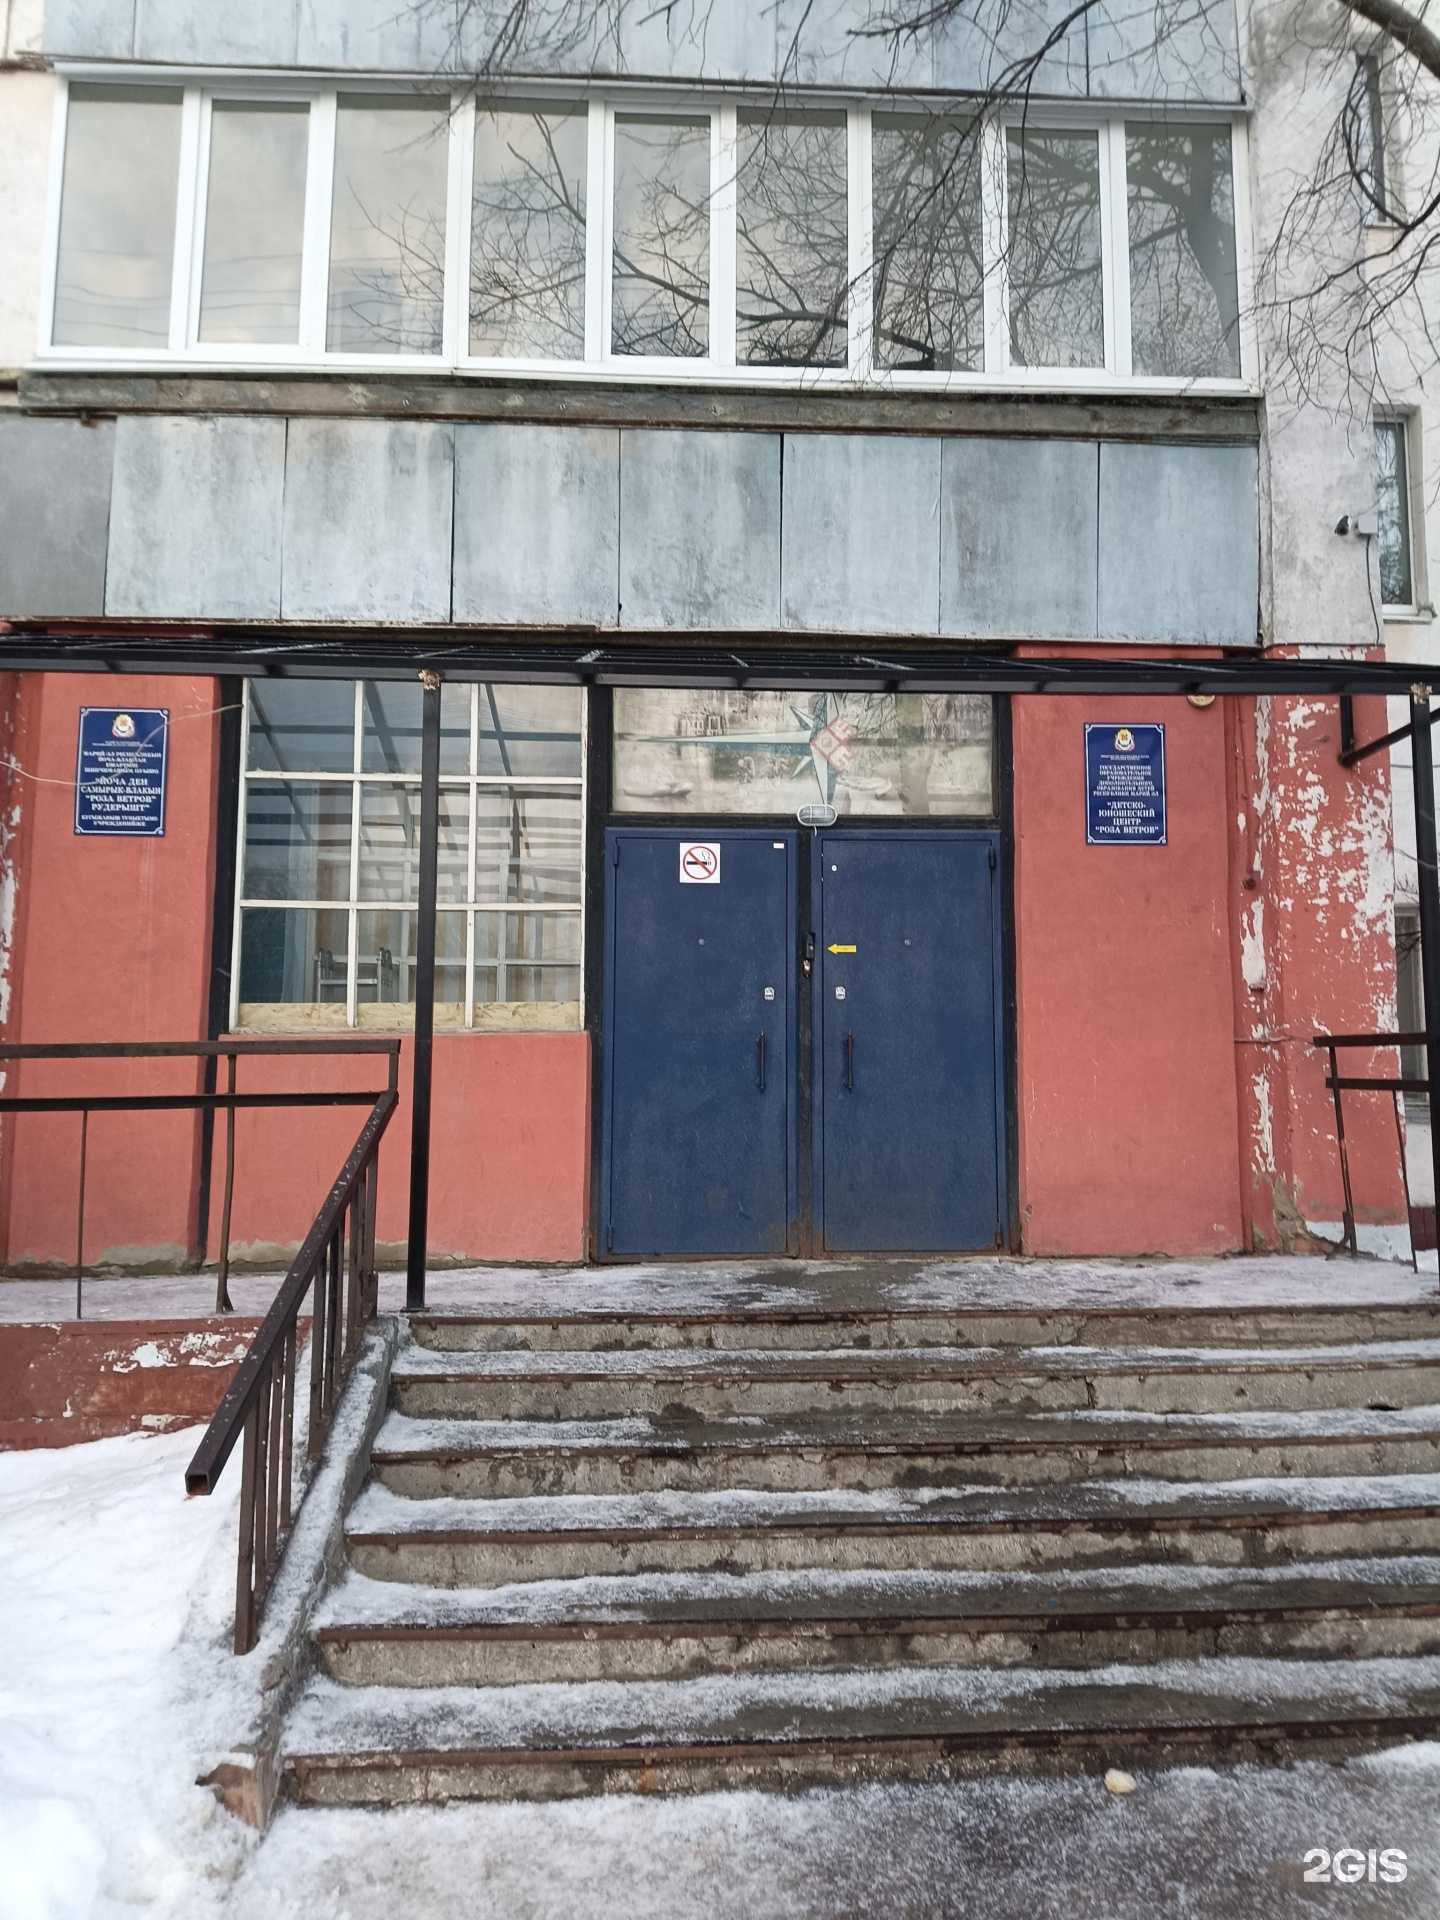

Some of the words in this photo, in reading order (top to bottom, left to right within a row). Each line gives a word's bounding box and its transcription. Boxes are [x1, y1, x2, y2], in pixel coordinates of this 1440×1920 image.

[128, 778, 148, 786] ДЕН
[1098, 809, 1155, 817] ЮНОШЕСКИЙ
[1113, 817, 1141, 826] ЦЕНТР
[1095, 826, 1120, 834] "РОЗА
[1123, 826, 1159, 834] ВЕТРОВ"
